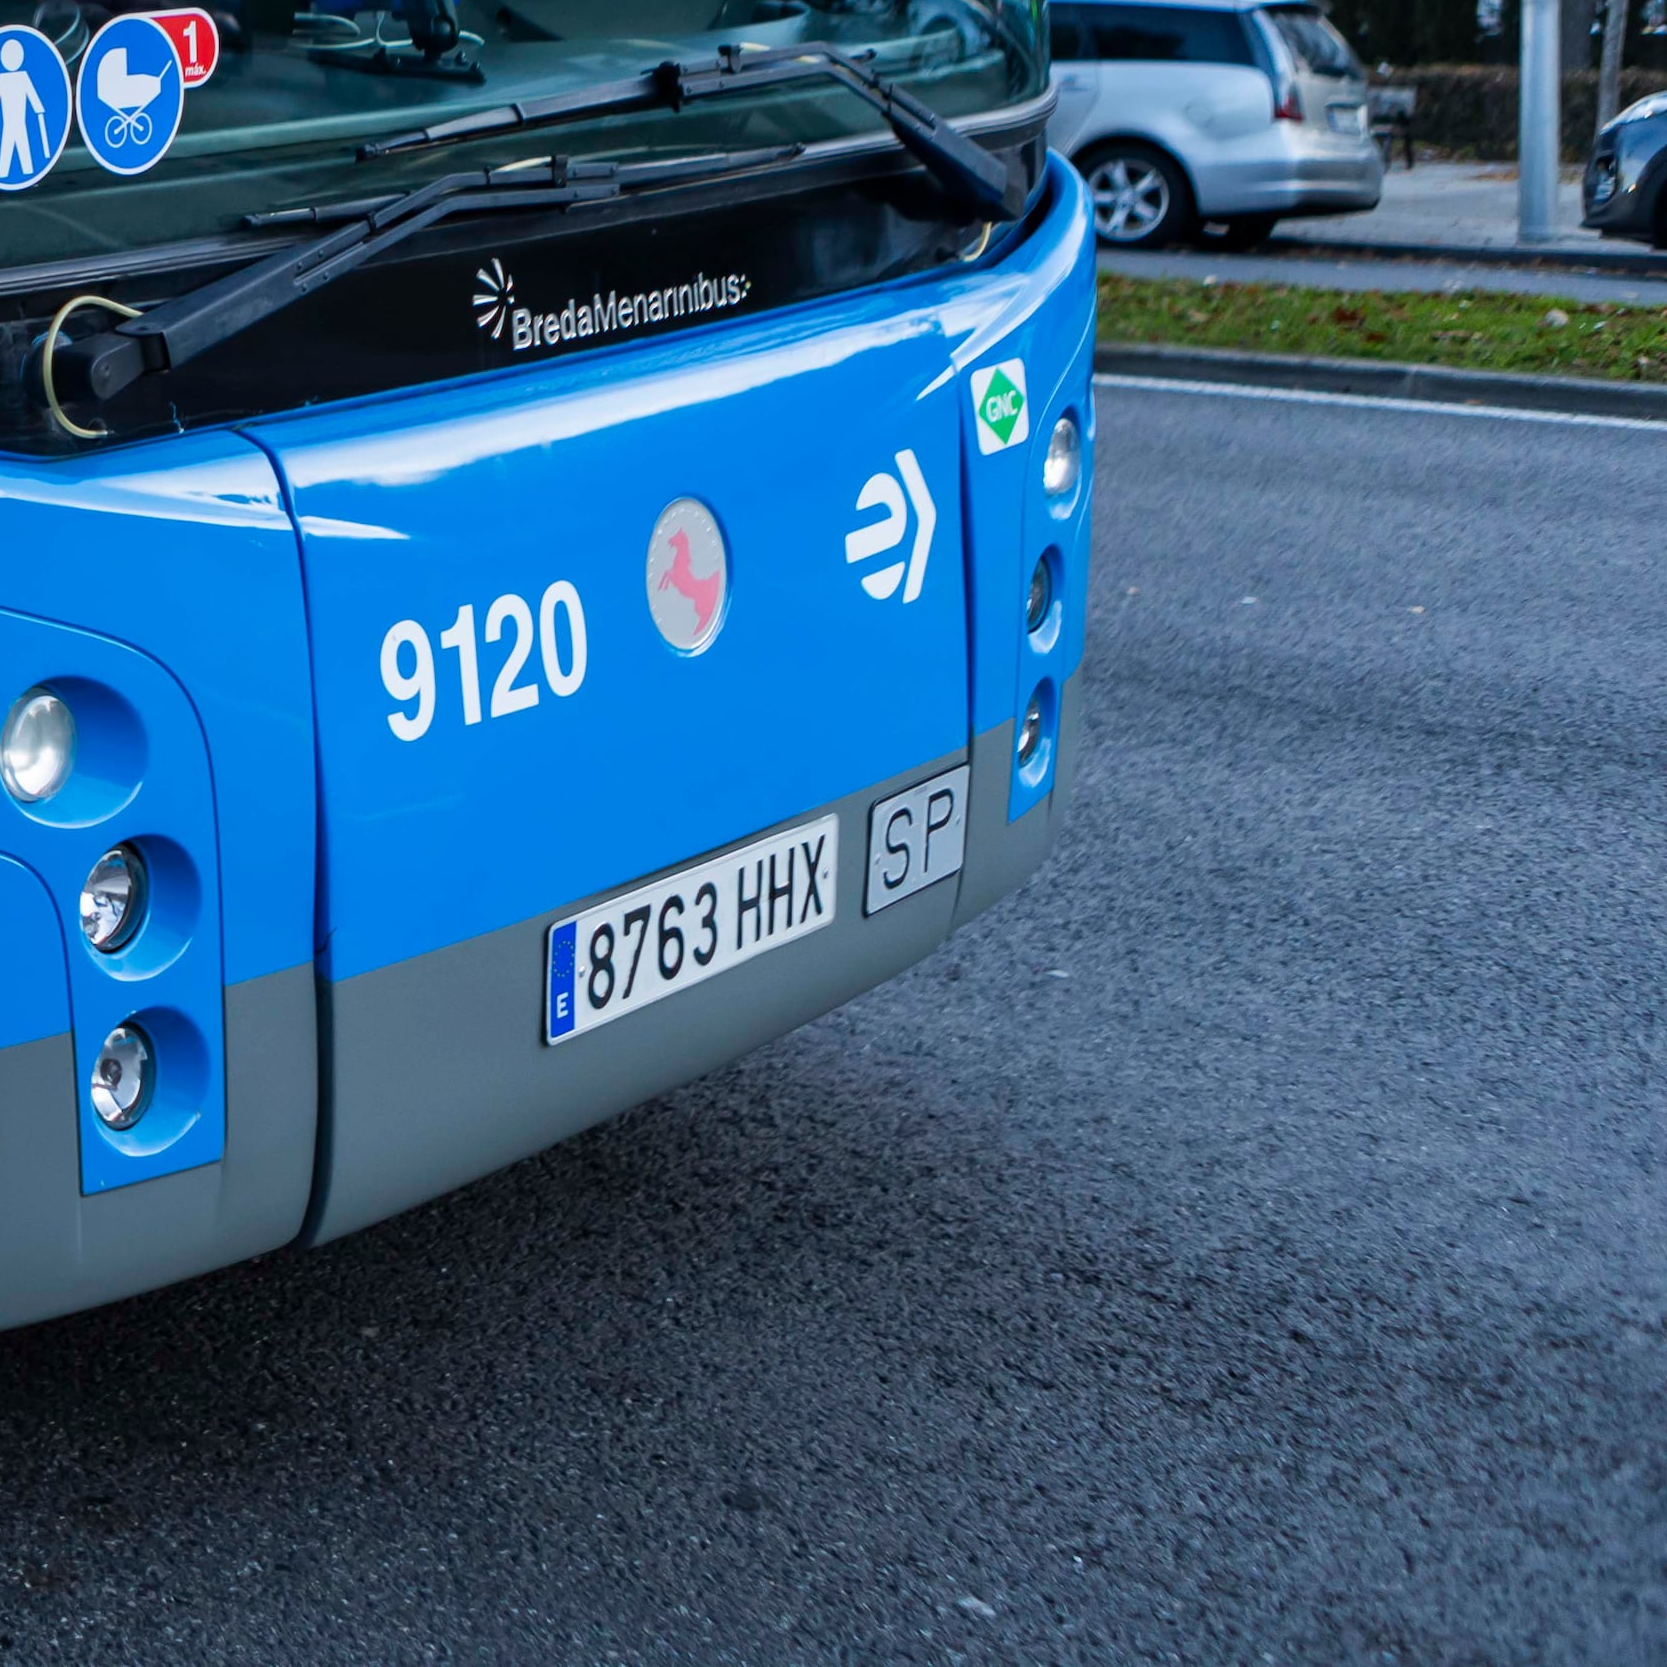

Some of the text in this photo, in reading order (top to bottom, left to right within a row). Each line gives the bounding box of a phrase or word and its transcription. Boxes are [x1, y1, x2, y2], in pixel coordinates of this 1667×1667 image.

[182, 20, 199, 64] 1
[185, 63, 206, 77] máx.
[985, 390, 1019, 423] GNC
[379, 579, 589, 743] 9120
[883, 788, 955, 891] SP
[587, 834, 827, 1010] 8763 HHX
[556, 992, 569, 1019] E
